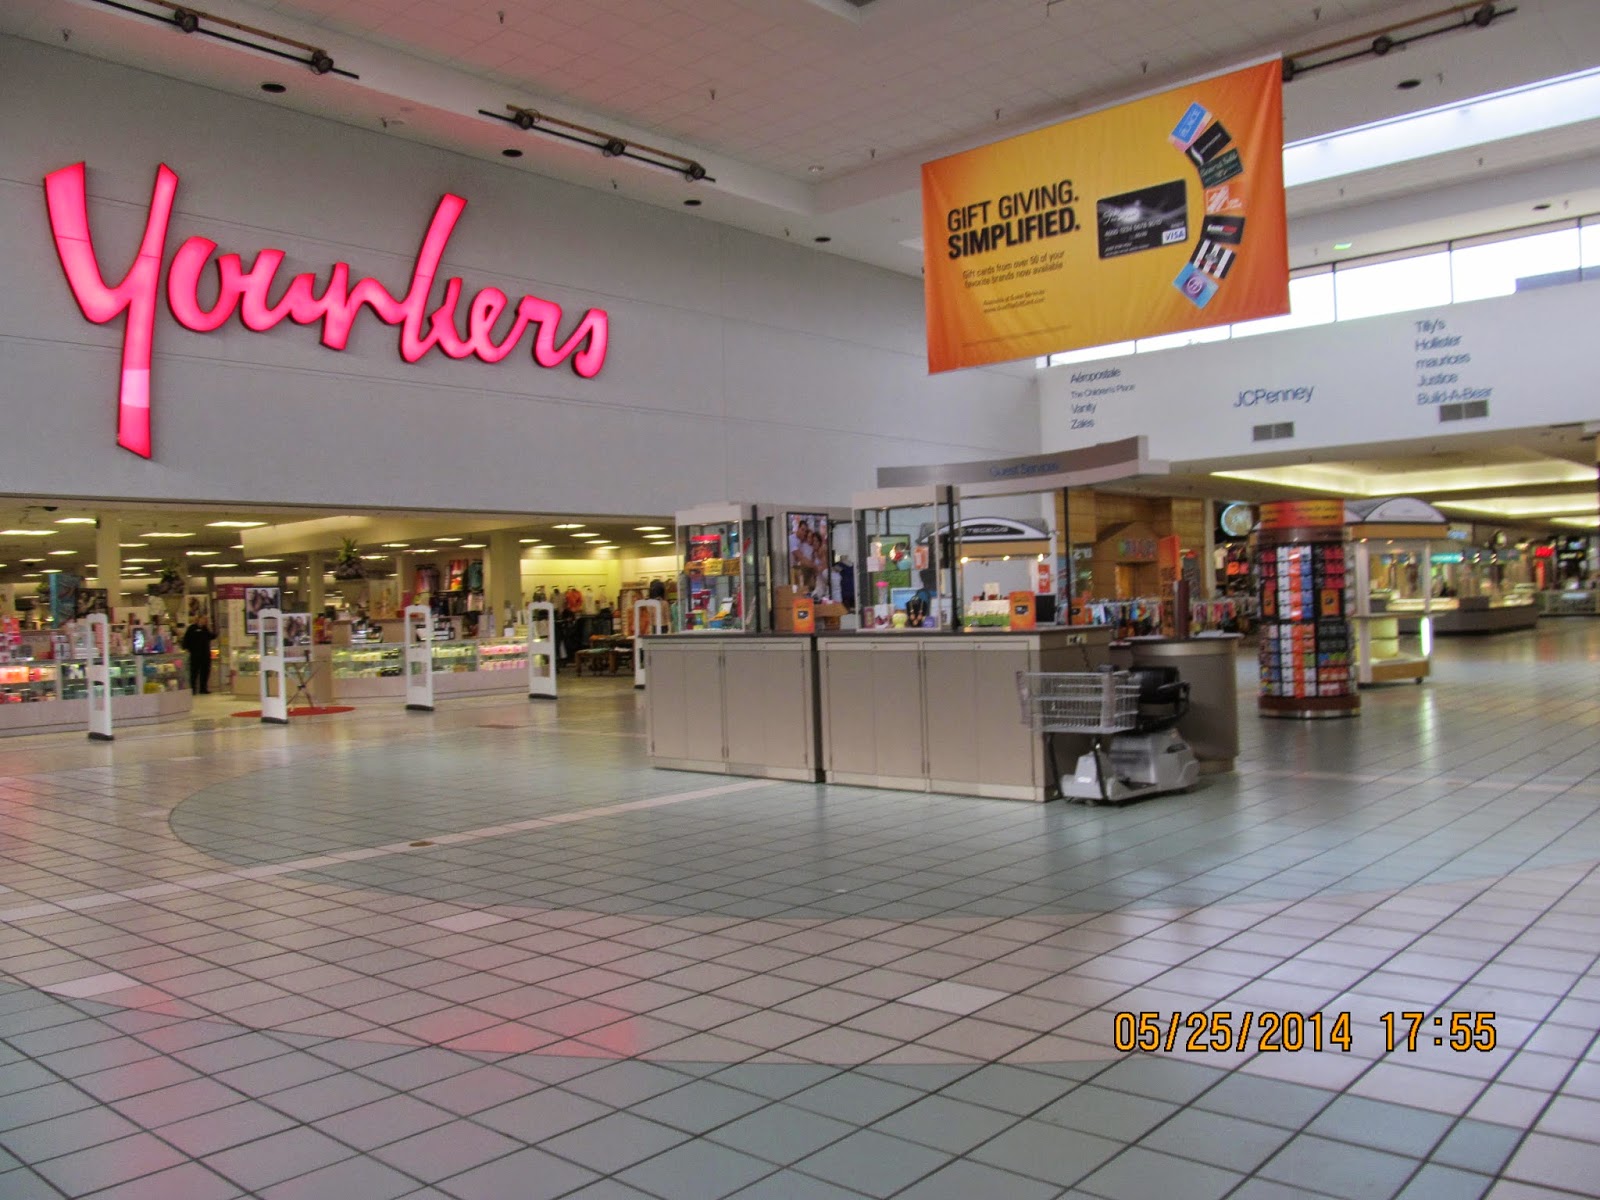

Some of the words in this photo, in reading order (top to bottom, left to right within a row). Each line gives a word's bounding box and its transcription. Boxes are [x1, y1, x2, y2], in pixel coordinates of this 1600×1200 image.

[947, 199, 992, 233] GIFT
[998, 178, 1080, 220] GIVING.
[948, 206, 1082, 260] SIMPLIFIED.
[1166, 229, 1185, 241] VISA
[963, 269, 976, 280] Gift
[977, 266, 995, 277] cards
[996, 262, 1013, 272] from
[1013, 259, 1029, 269] over
[1030, 254, 1040, 265] 50
[1049, 250, 1065, 262] your
[964, 276, 991, 288] favorite
[991, 270, 1015, 284] brands
[1016, 268, 1032, 279] now
[1032, 261, 1063, 275] available
[43, 161, 610, 460] Younkers
[1414, 318, 1446, 334] Tilly's
[1415, 335, 1462, 351] Hollister
[1416, 353, 1471, 369] maurices
[1116, 383, 1136, 393] Place
[1417, 373, 1459, 387] Justice
[1232, 385, 1316, 408] JCPenney
[1417, 387, 1494, 406] Build-A-Bear
[1071, 401, 1097, 415] Vanity
[1070, 418, 1095, 430] Zales
[1020, 462, 1060, 475] Services
